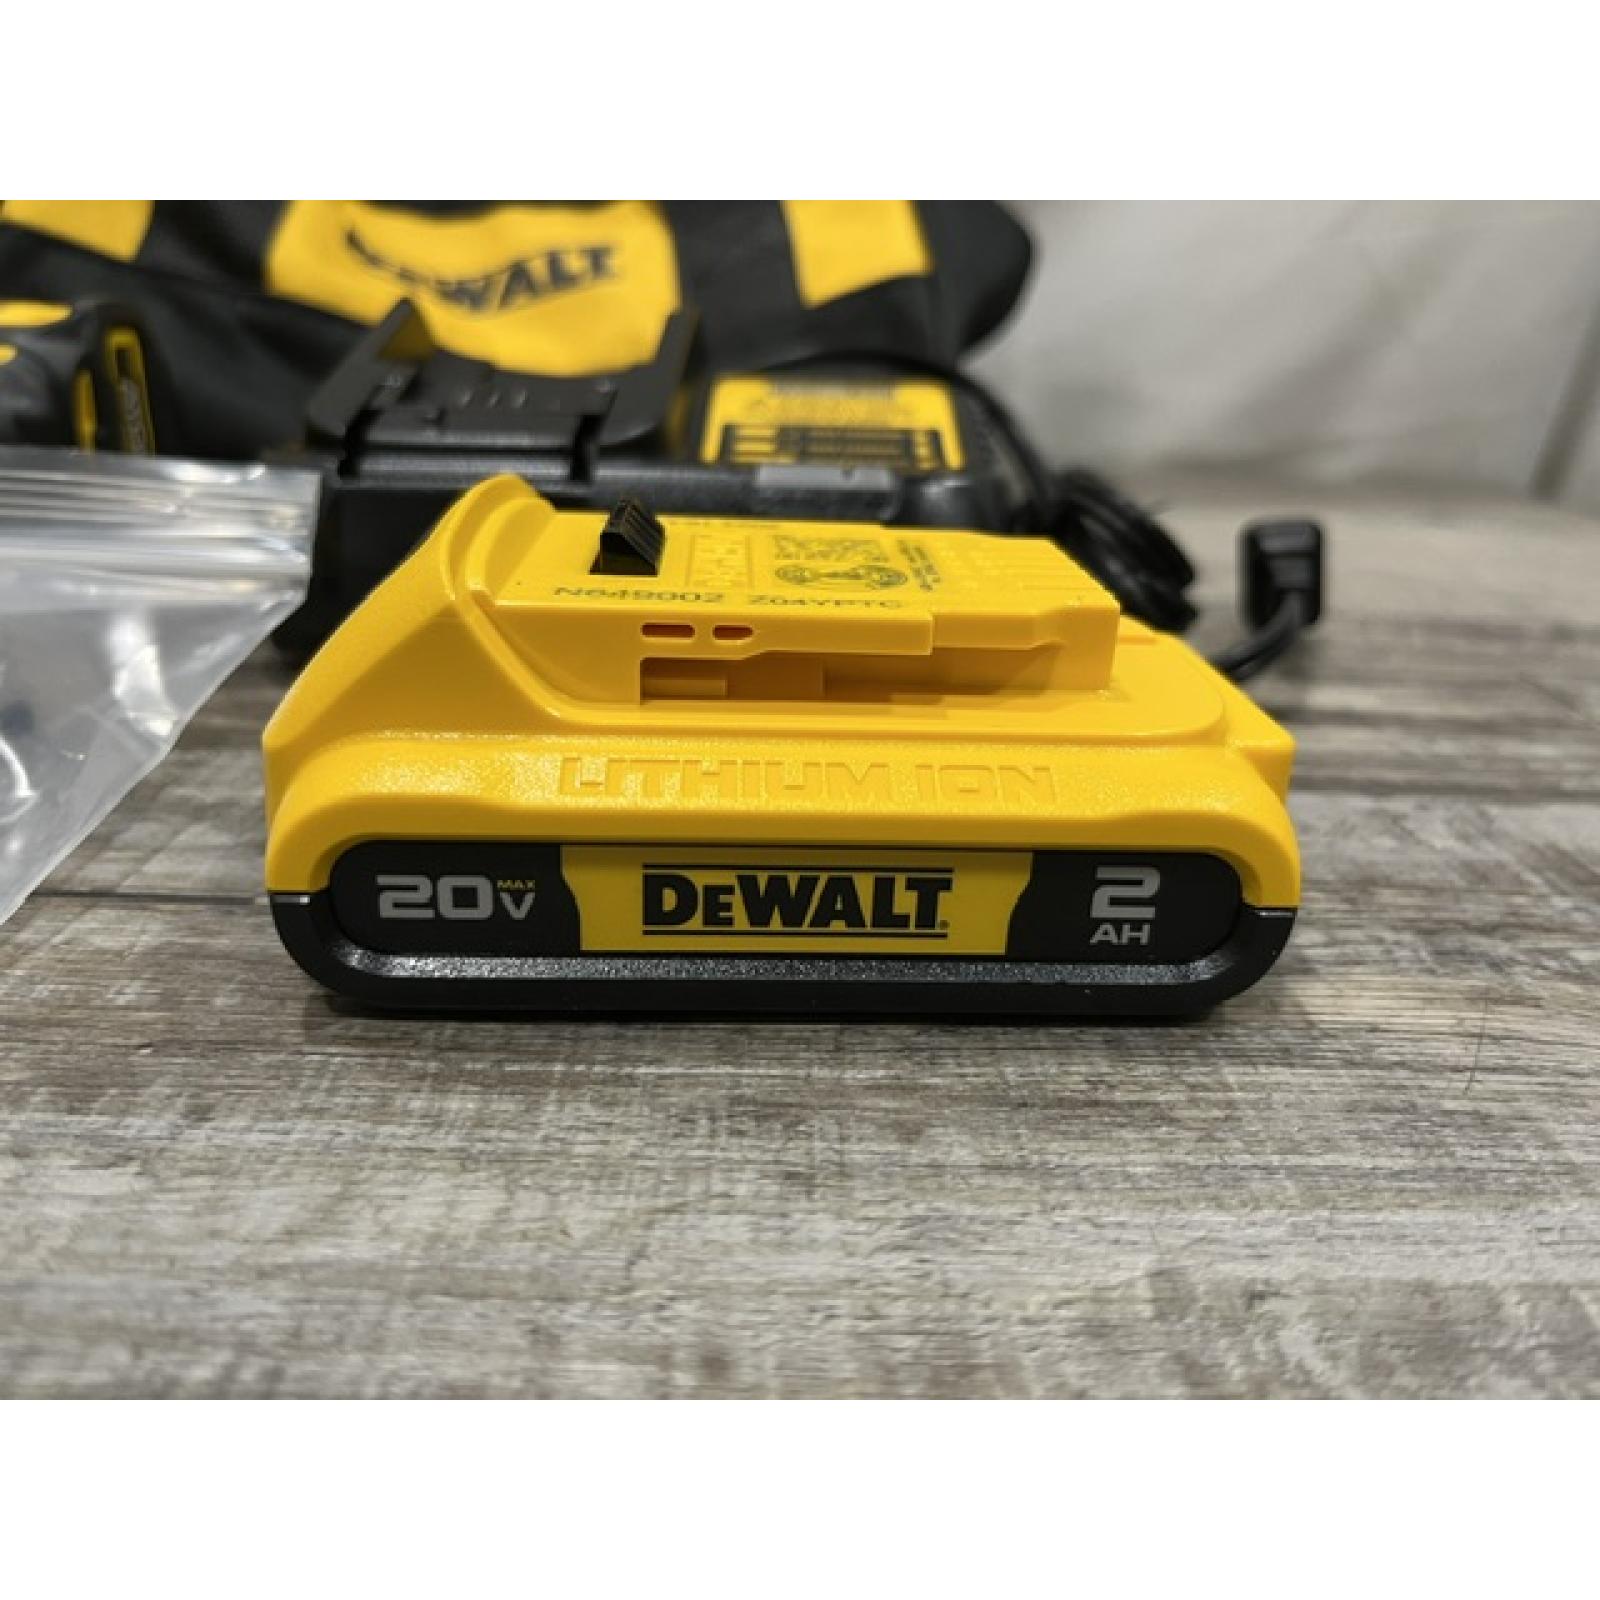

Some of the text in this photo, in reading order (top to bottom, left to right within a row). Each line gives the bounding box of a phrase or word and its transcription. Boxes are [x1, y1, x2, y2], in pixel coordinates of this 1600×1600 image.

[346, 228, 614, 315] WALT
[560, 757, 1057, 804] LITHIUM ION
[497, 879, 536, 889] MAX
[642, 873, 954, 929] DEWALT
[1090, 866, 1161, 919] 2
[1089, 923, 1152, 946] AH
